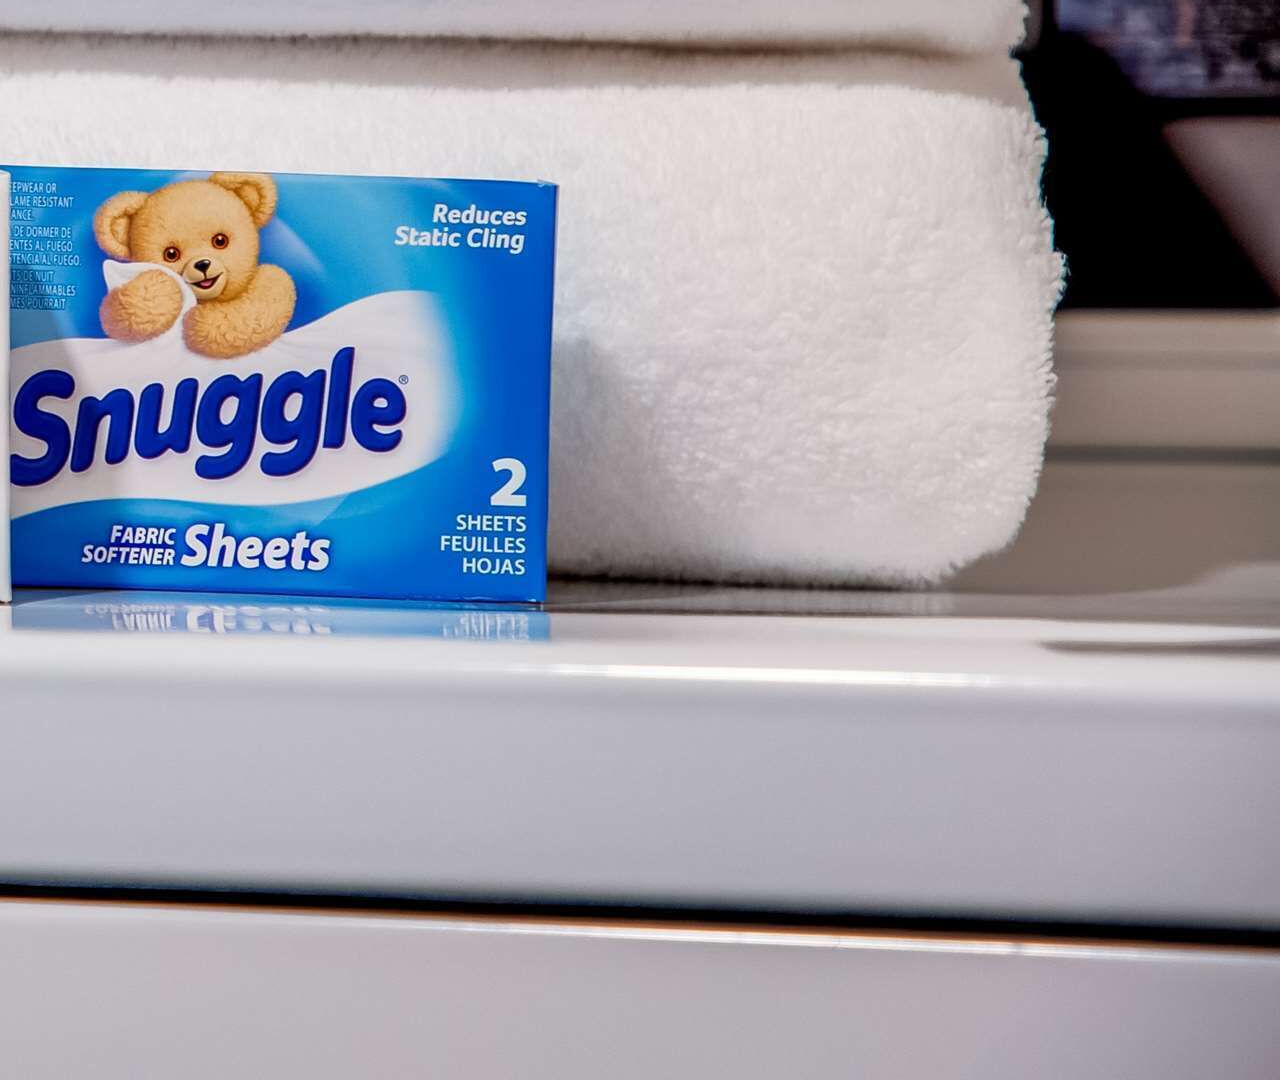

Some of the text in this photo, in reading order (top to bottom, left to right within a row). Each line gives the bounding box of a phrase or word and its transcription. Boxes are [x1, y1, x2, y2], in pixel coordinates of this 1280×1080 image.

[46, 183, 57, 194] OR
[10, 196, 74, 208] LAME RESISTANT
[432, 203, 527, 226] Reduces
[14, 225, 72, 238] DE DORMER DE
[394, 225, 525, 255] Static Cling
[10, 239, 73, 252] ENTES AL FUEGO
[42, 253, 51, 265] AL
[23, 270, 33, 281] DE
[35, 270, 54, 281] NUIT
[27, 298, 66, 310] POURRAIT
[10, 346, 407, 486] Snuggle
[490, 457, 527, 507] 2
[456, 514, 527, 532] SHEETS
[110, 524, 176, 545] FABRIC
[180, 523, 331, 571] Sheets
[440, 535, 527, 554] FEUILLES
[81, 544, 176, 565] SOFTENER
[462, 557, 526, 576] HOJAS
